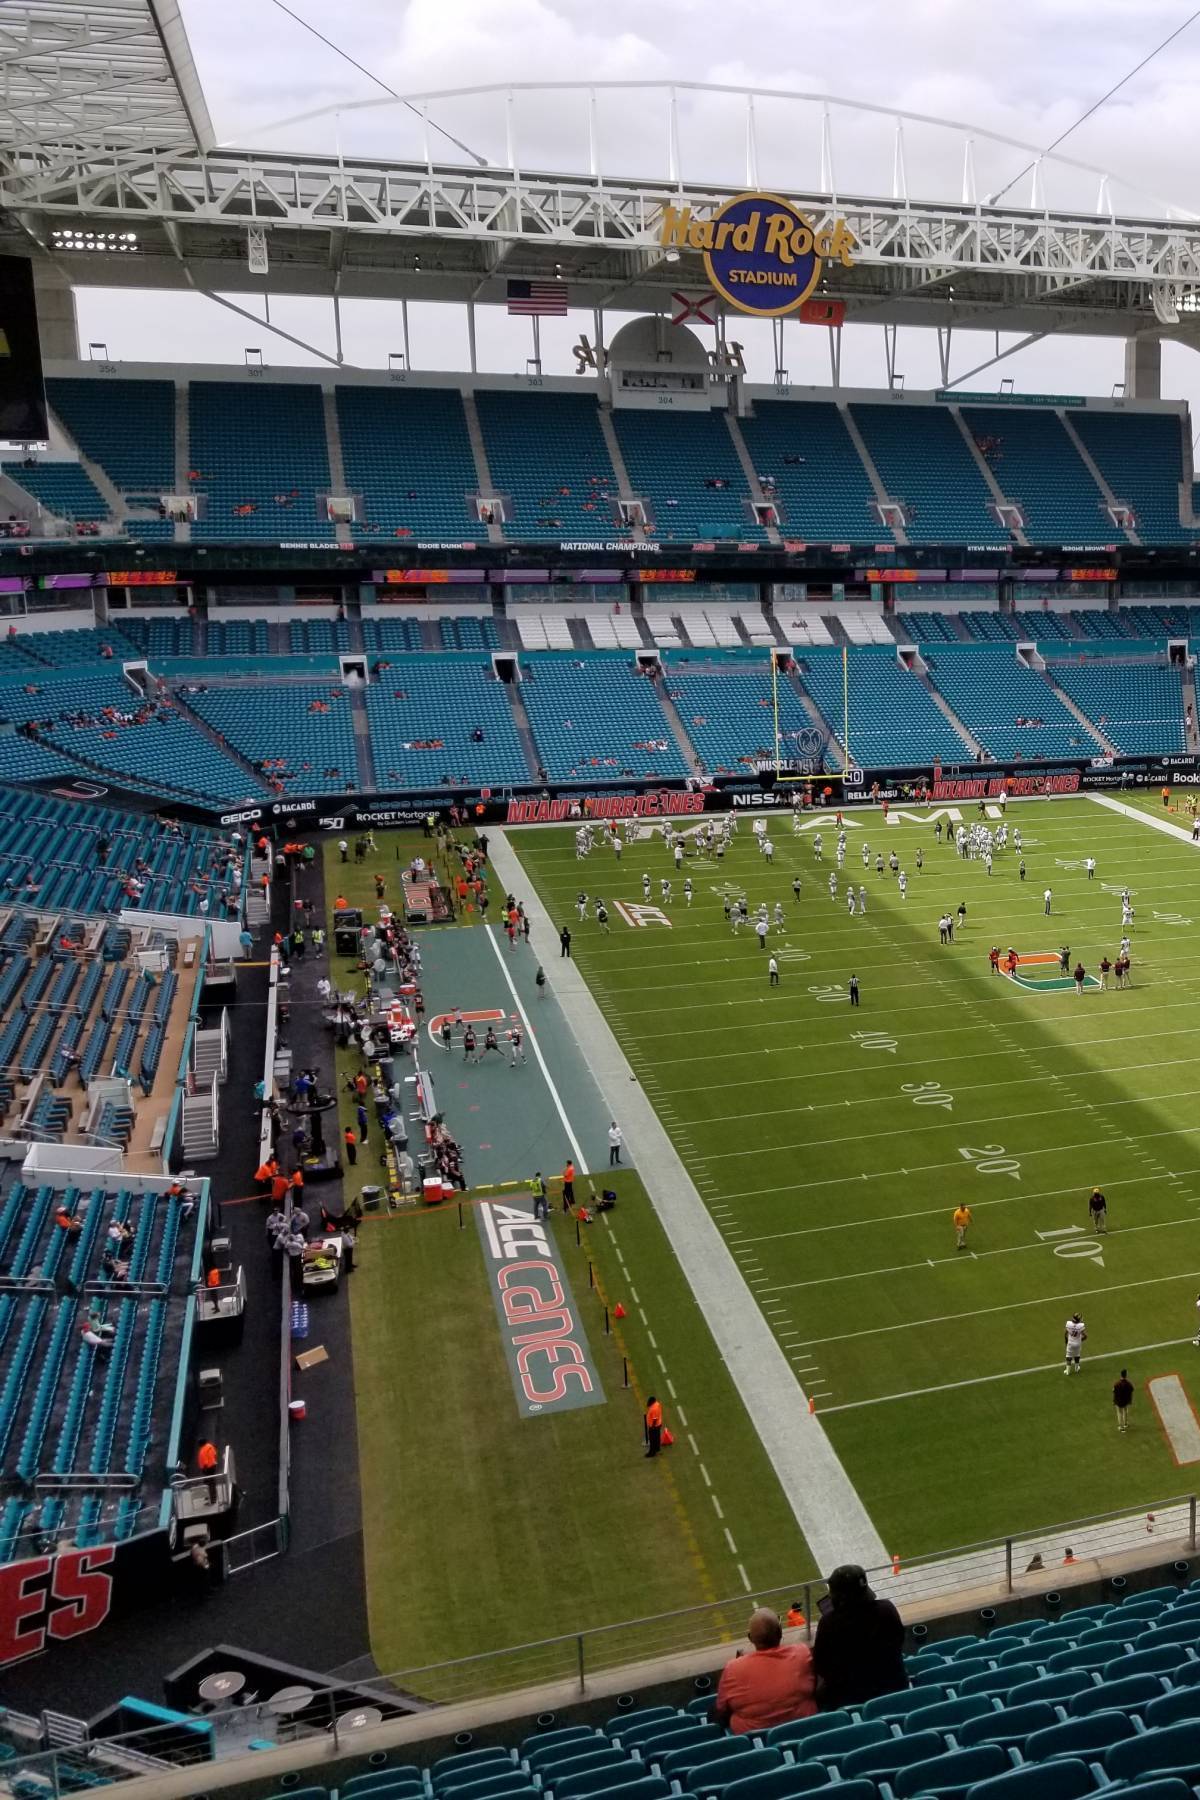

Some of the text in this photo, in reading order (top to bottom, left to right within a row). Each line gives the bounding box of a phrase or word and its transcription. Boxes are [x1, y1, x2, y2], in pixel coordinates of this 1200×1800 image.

[661, 206, 855, 268] Hard Rock
[729, 269, 798, 287] STADIUM
[98, 364, 117, 374] 356
[247, 369, 264, 378] 301
[390, 374, 406, 382] 302
[657, 396, 673, 404] 304
[560, 542, 660, 551] NATIONAL CHAMPIONS
[756, 759, 794, 771] MUSCLE
[1170, 756, 1195, 765] BACARDÍ
[934, 780, 987, 799] MIAMI
[281, 799, 317, 813] BACARDÍ
[507, 798, 574, 823] MIAM
[220, 808, 262, 825] GEICO
[356, 812, 396, 821] ROCKET
[807, 985, 852, 1002] 50
[850, 1030, 899, 1049] 40
[901, 1081, 954, 1106] 30
[958, 1144, 1021, 1173] 20
[492, 1203, 552, 1258] ACC
[1034, 1225, 1103, 1258] 10
